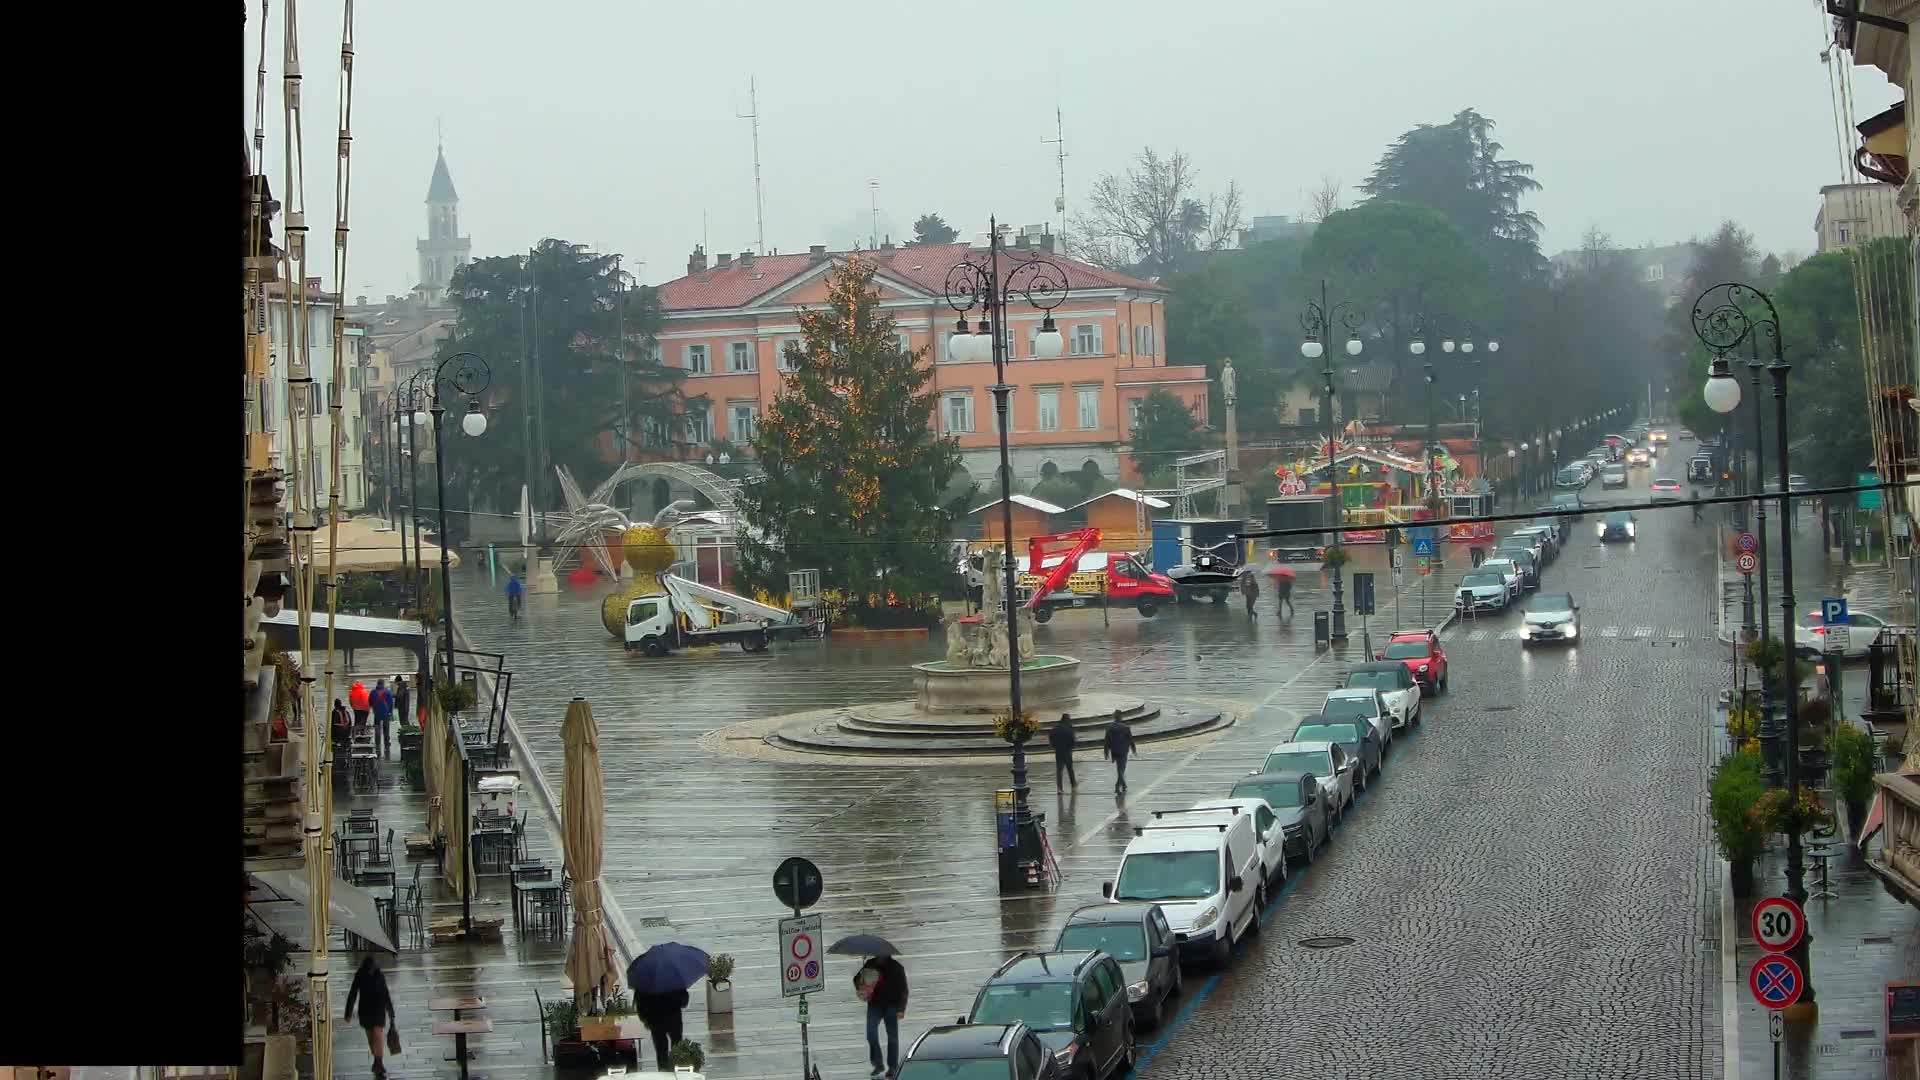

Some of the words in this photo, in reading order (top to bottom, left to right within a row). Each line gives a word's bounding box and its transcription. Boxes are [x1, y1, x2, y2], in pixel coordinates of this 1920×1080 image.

[1742, 557, 1753, 567] 20
[1827, 602, 1842, 622] P
[1762, 911, 1792, 937] 30
